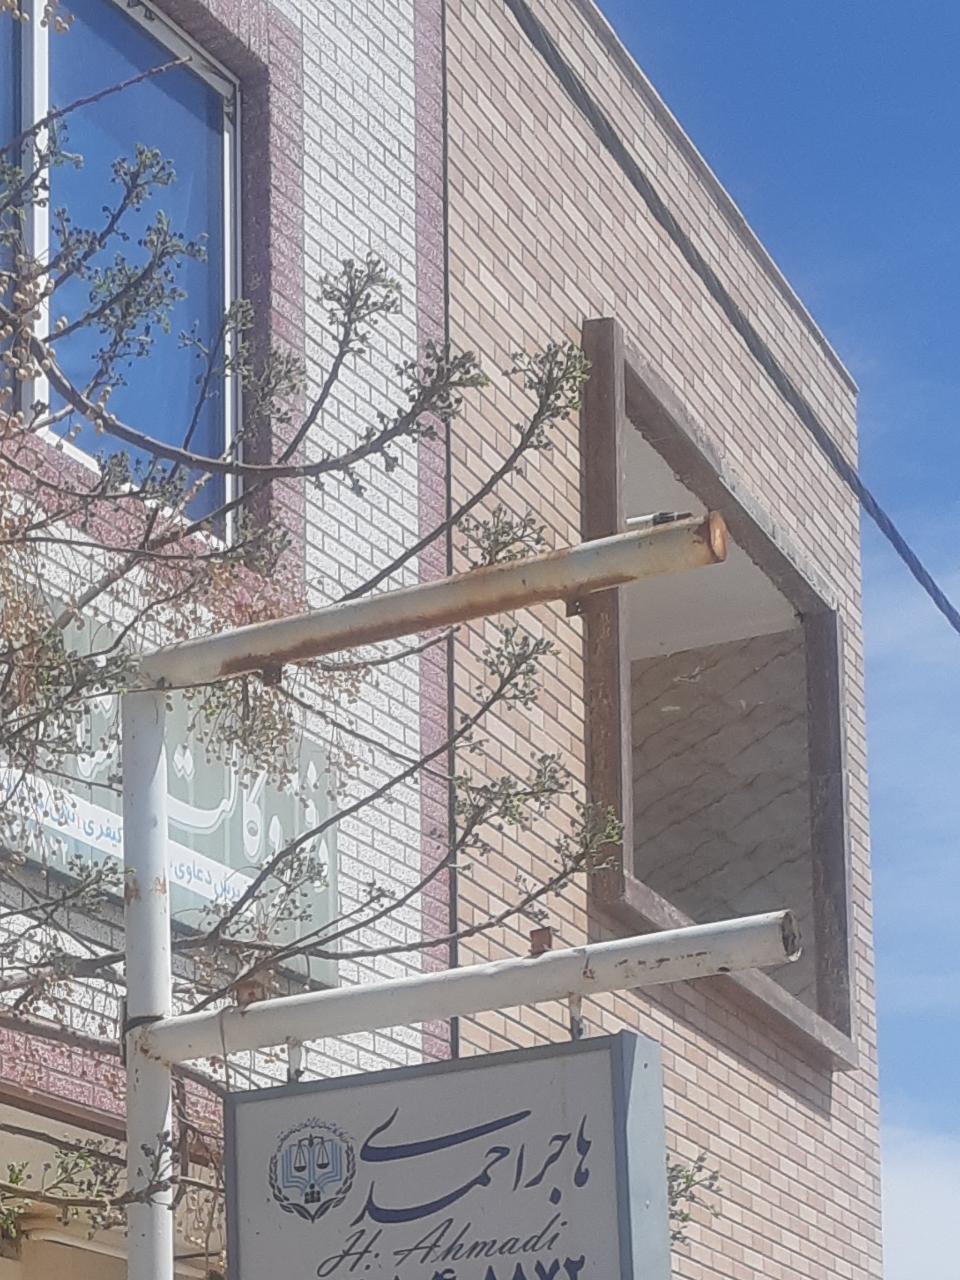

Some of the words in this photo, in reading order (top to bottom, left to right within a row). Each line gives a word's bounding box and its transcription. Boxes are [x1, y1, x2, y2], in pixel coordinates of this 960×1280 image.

[174, 858, 212, 885] دعاوی
[349, 1106, 534, 1228] احمدی
[523, 1113, 593, 1206] هاجر
[316, 1228, 382, 1278] H.
[393, 1212, 568, 1267] Ahmadi
